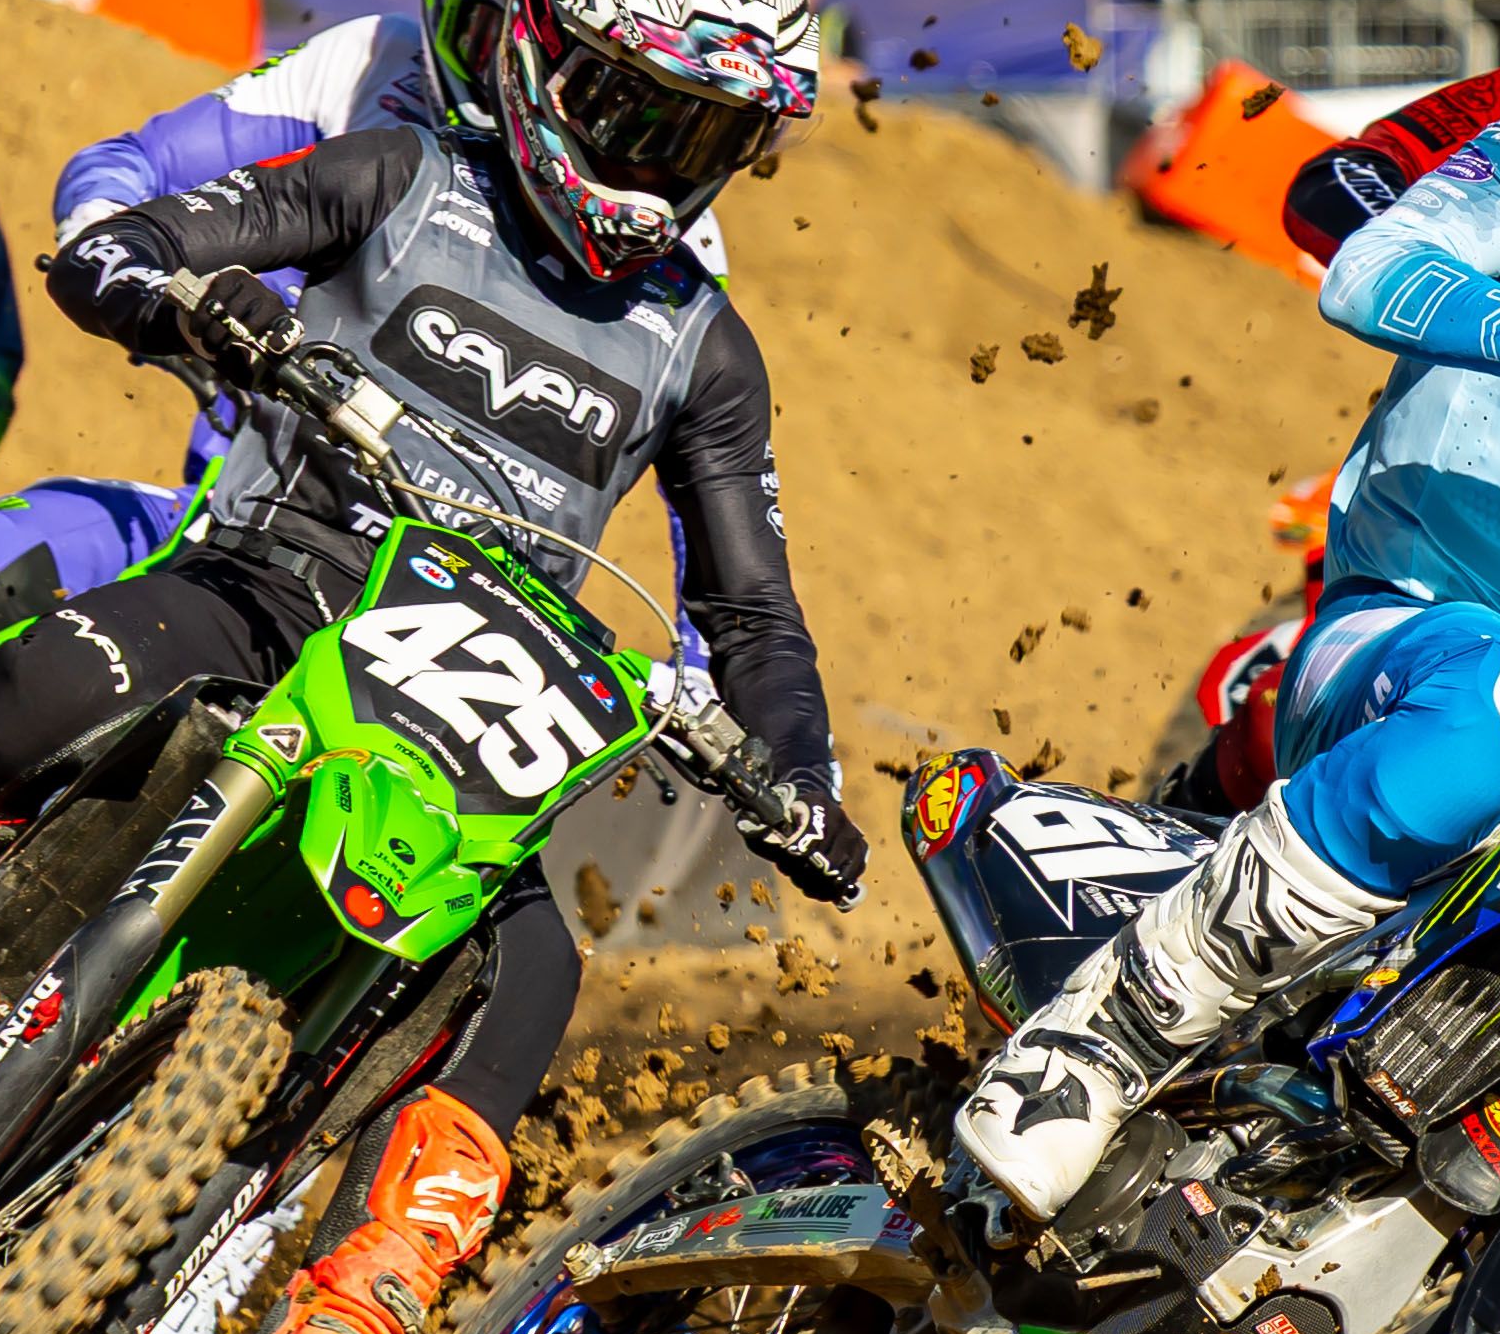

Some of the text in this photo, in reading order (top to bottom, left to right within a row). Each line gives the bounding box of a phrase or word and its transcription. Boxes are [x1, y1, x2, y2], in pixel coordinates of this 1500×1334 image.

[719, 57, 761, 82] BELL
[427, 210, 493, 248] MOTUL
[469, 571, 580, 669] SUPERCROSS
[341, 601, 607, 798] 425
[422, 733, 466, 777] GORDON
[444, 892, 476, 912] TWISTED
[758, 1194, 864, 1221] YAMALUBE
[163, 1167, 270, 1309] DUNLOP
